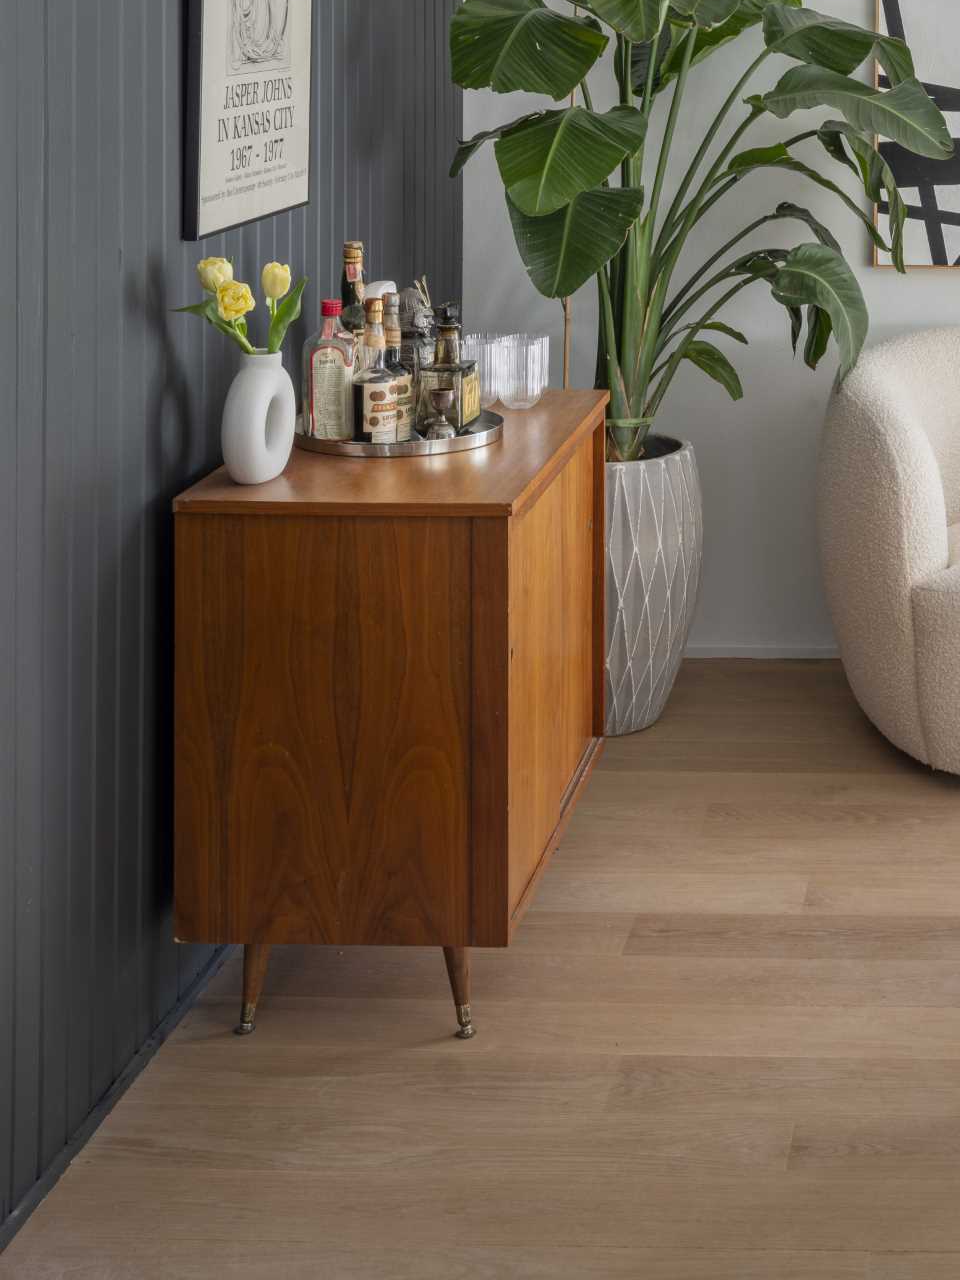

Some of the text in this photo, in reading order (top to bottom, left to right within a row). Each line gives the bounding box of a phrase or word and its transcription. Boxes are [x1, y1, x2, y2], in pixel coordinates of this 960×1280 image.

[223, 77, 292, 110] JASPER JOHNS
[217, 105, 295, 143] IN KANSAS CITY
[230, 145, 253, 171] 1967
[263, 138, 284, 163] 1977
